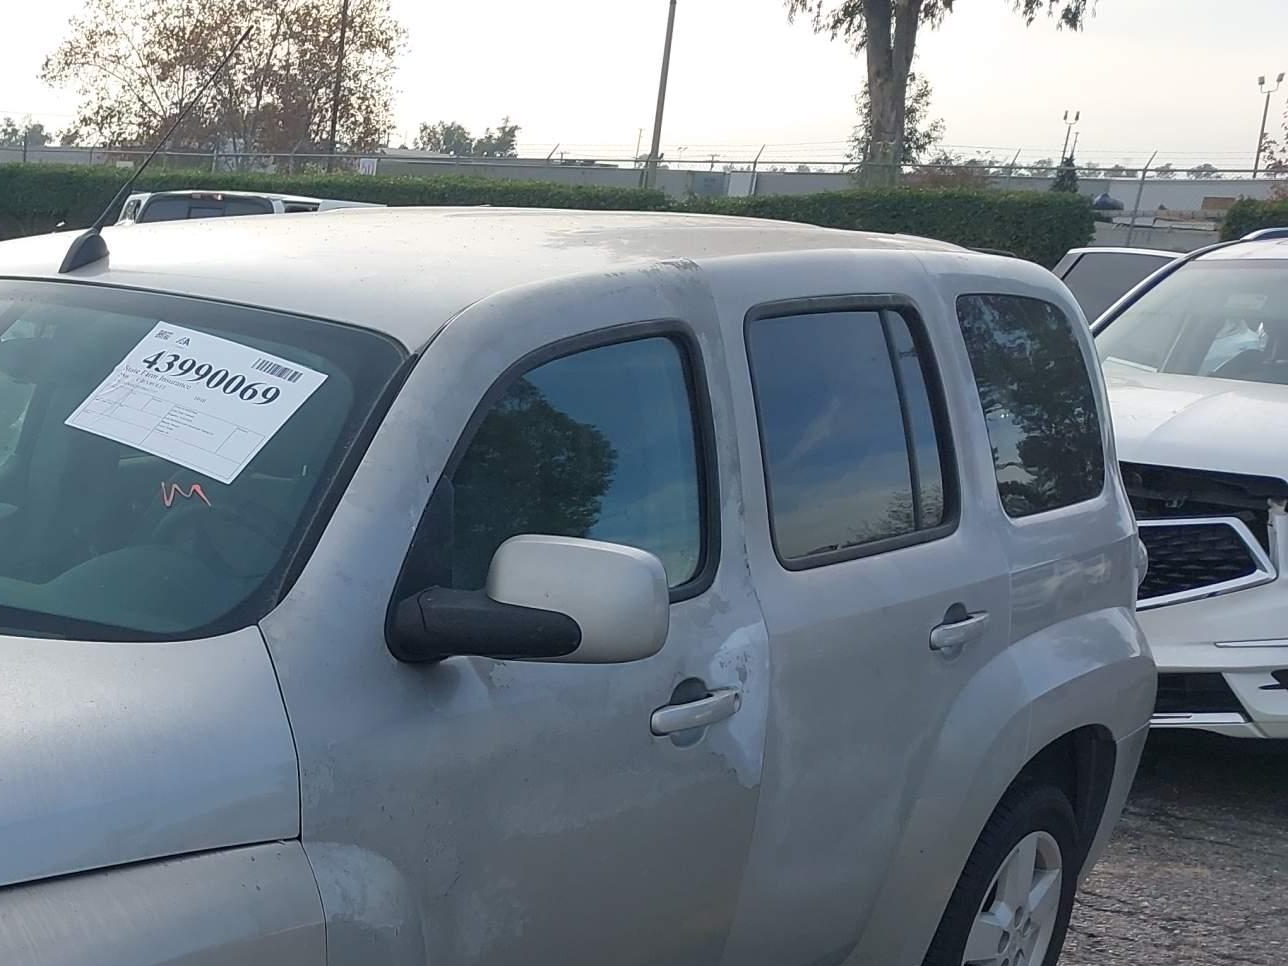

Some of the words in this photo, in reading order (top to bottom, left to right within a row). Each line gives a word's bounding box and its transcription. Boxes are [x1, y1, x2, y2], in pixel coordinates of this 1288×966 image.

[123, 364, 141, 375] State
[141, 369, 159, 380] Farm
[159, 375, 192, 391] Insurance
[142, 350, 281, 405] 43990069
